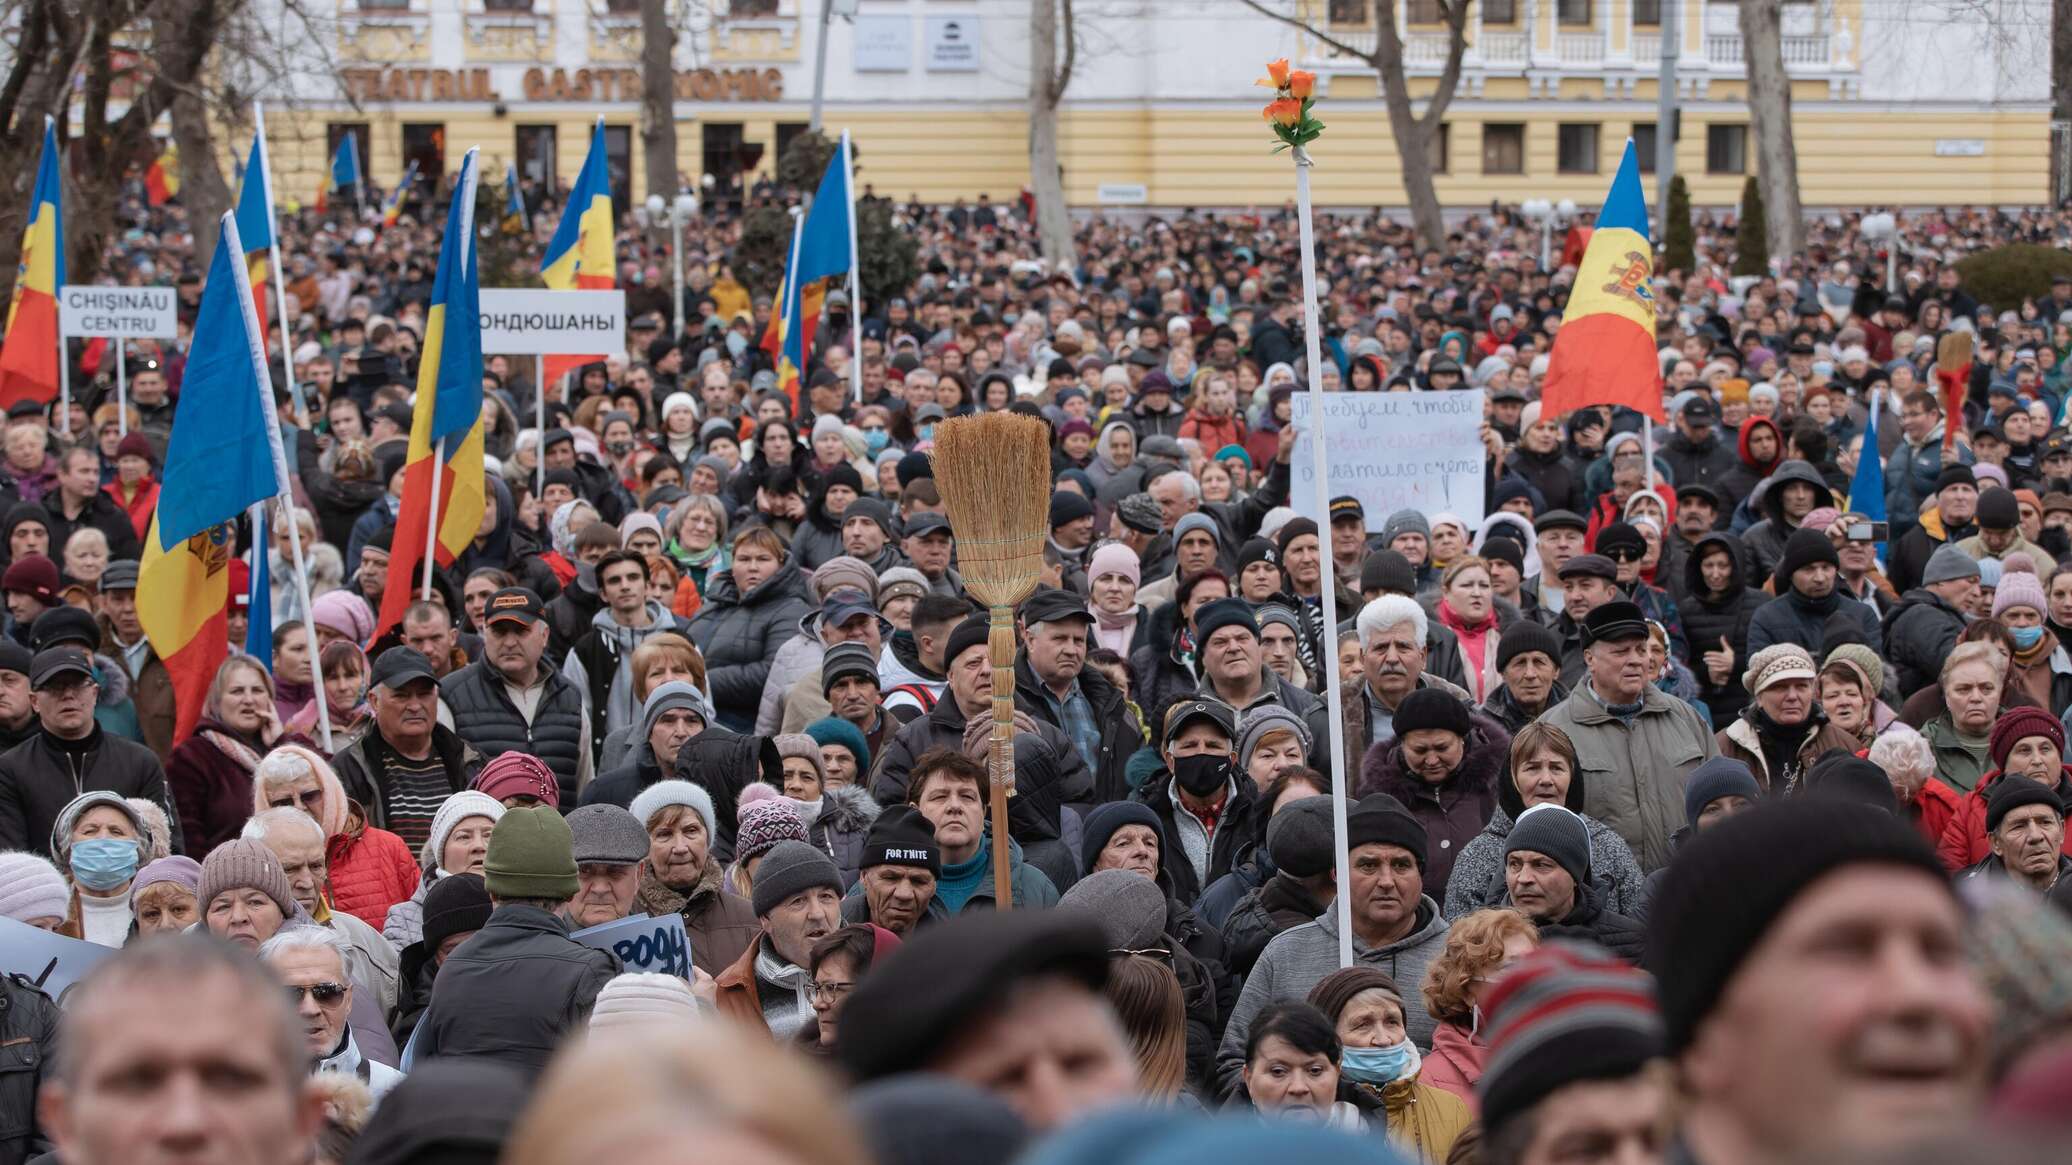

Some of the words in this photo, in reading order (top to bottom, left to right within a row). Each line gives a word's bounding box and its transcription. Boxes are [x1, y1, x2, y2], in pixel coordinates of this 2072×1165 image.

[339, 68, 499, 101] TEATRUL
[522, 67, 785, 101] GASTRNOMIC
[81, 316, 157, 332] CENTRU
[1302, 463, 1417, 482] олатило
